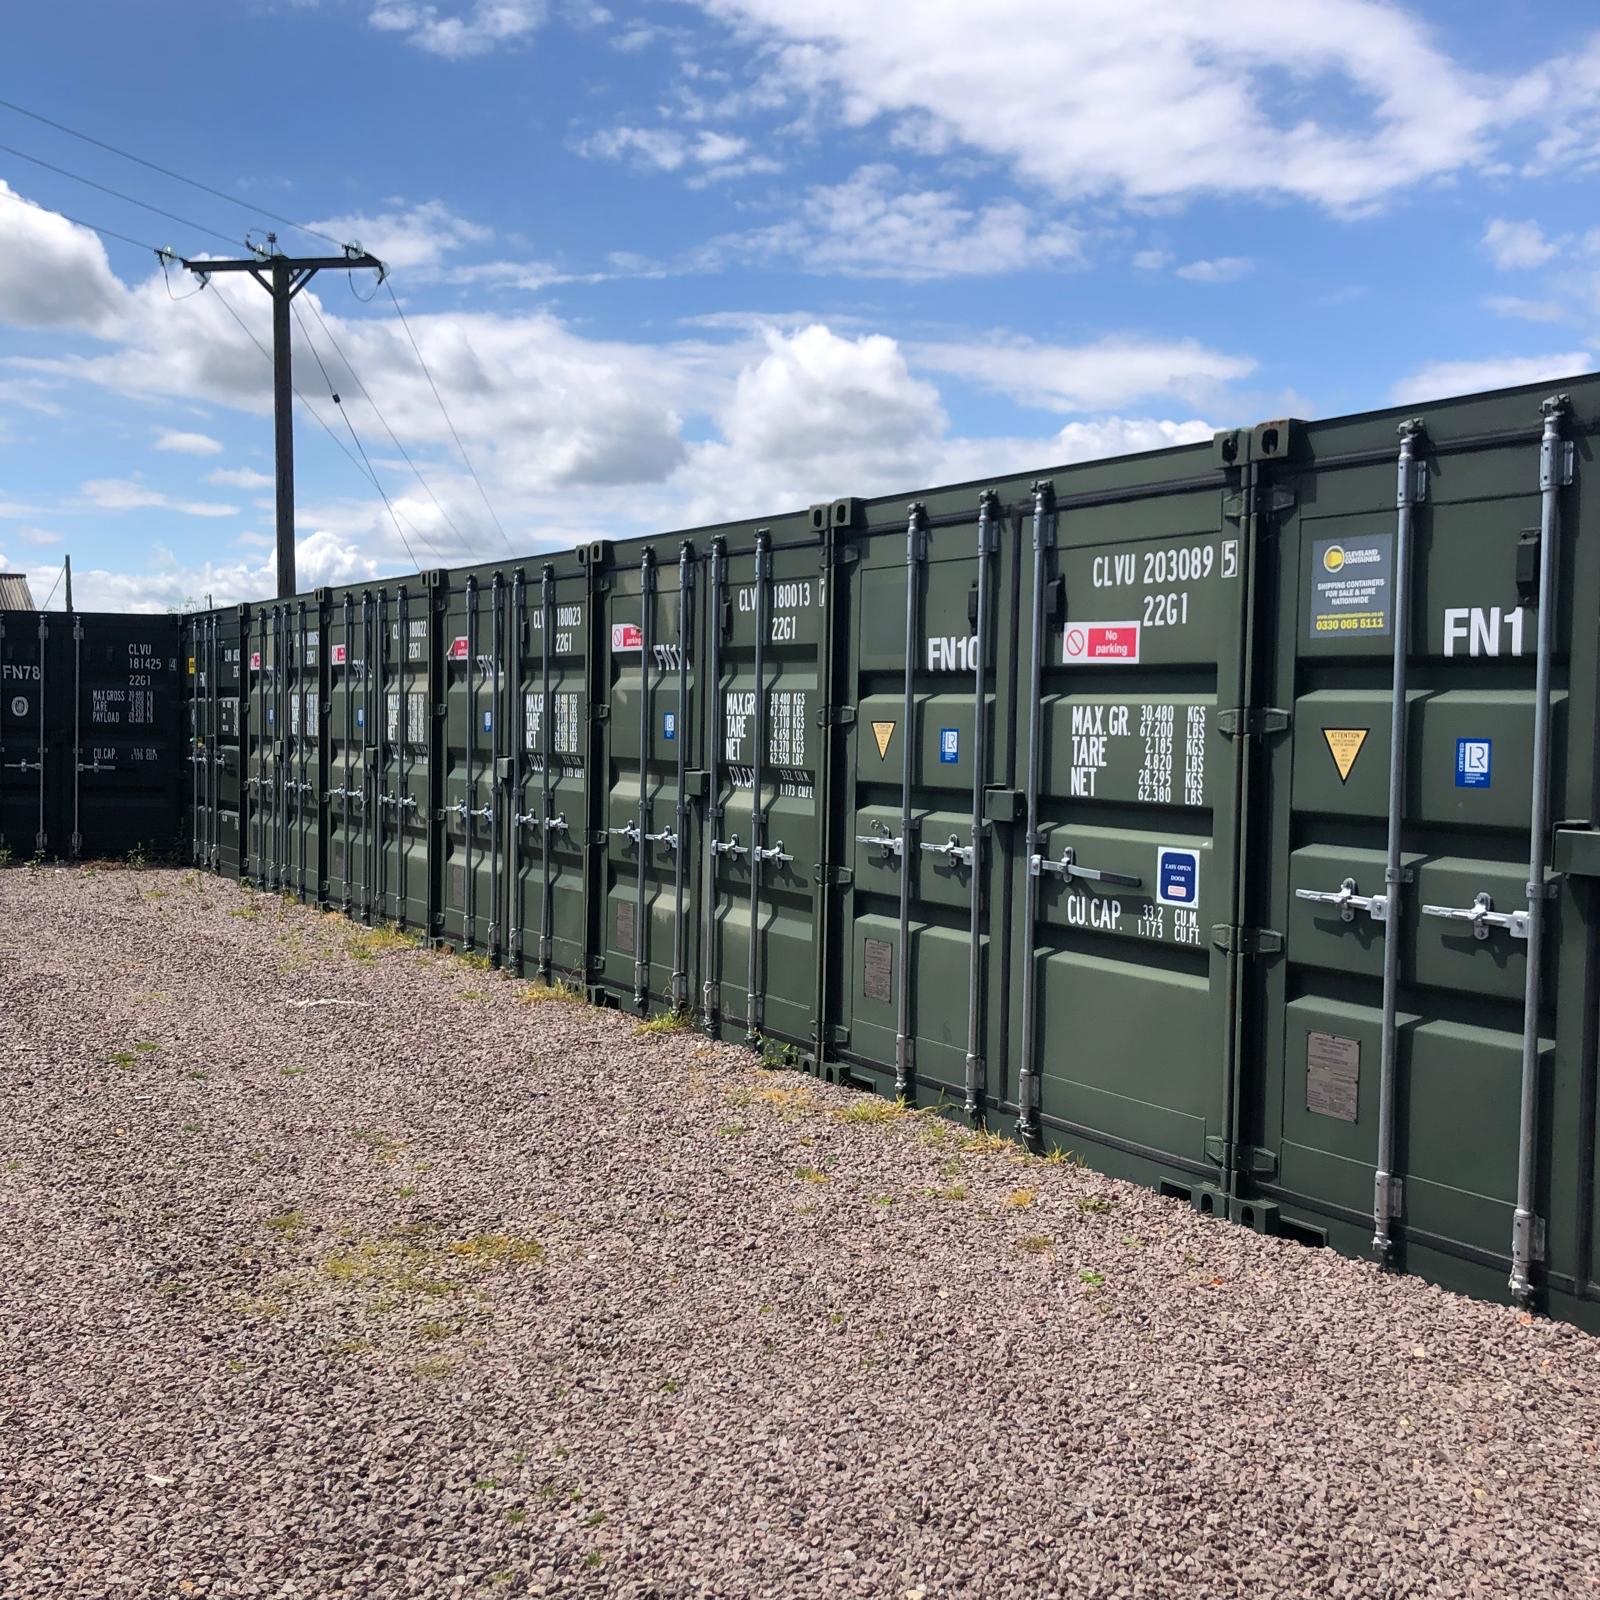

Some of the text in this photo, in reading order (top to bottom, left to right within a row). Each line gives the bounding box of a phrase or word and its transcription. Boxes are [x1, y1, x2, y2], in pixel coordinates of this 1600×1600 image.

[1345, 549, 1378, 558] CLEVELAND
[1345, 555, 1380, 564] CONTAINERS
[1093, 542, 1236, 587] CLVU 203089 5
[1318, 579, 1384, 590] SHIPPING CONTAINERS
[1326, 590, 1338, 598] FOR
[1339, 588, 1354, 597] SALE
[1361, 587, 1376, 596] HIRE
[739, 587, 757, 612] CLV
[774, 582, 810, 608] 180013
[1332, 596, 1368, 605] NATIONWIDE
[557, 606, 581, 627] 180023
[1143, 592, 1188, 626] 22G1
[772, 616, 796, 640] 22G1
[1316, 618, 1384, 630] 0330 005 5111
[1444, 607, 1524, 657] FN1
[556, 632, 572, 652] 22G1
[1105, 630, 1118, 640] No
[128, 644, 151, 655] CLVU
[1096, 643, 1128, 656] parking
[129, 658, 161, 670] 181425
[3, 665, 40, 680] FN78
[130, 675, 150, 686] 22G1
[93, 701, 108, 712] TARE
[793, 692, 805, 705] KGS
[93, 712, 120, 723] PAYLOAD
[793, 705, 804, 717] LBS
[1140, 705, 1174, 722] 30.480
[1187, 706, 1206, 722] KGS
[526, 712, 540, 730] TARE
[726, 716, 746, 738] TARE
[793, 717, 805, 729] KGS
[793, 729, 804, 741] LBS
[1140, 722, 1205, 739] 67.200 LBS
[526, 731, 536, 748] NET
[726, 738, 741, 760] NET
[793, 741, 805, 753] KGS
[1072, 736, 1204, 766] TARE 2.185 KGS
[792, 753, 803, 766] LBS
[1144, 754, 1204, 772] 4.820 LBS
[1071, 766, 1203, 796] NET 28.295 KGS
[1138, 786, 1202, 804] 62.380 LBS
[1143, 904, 1164, 922] 33.2
